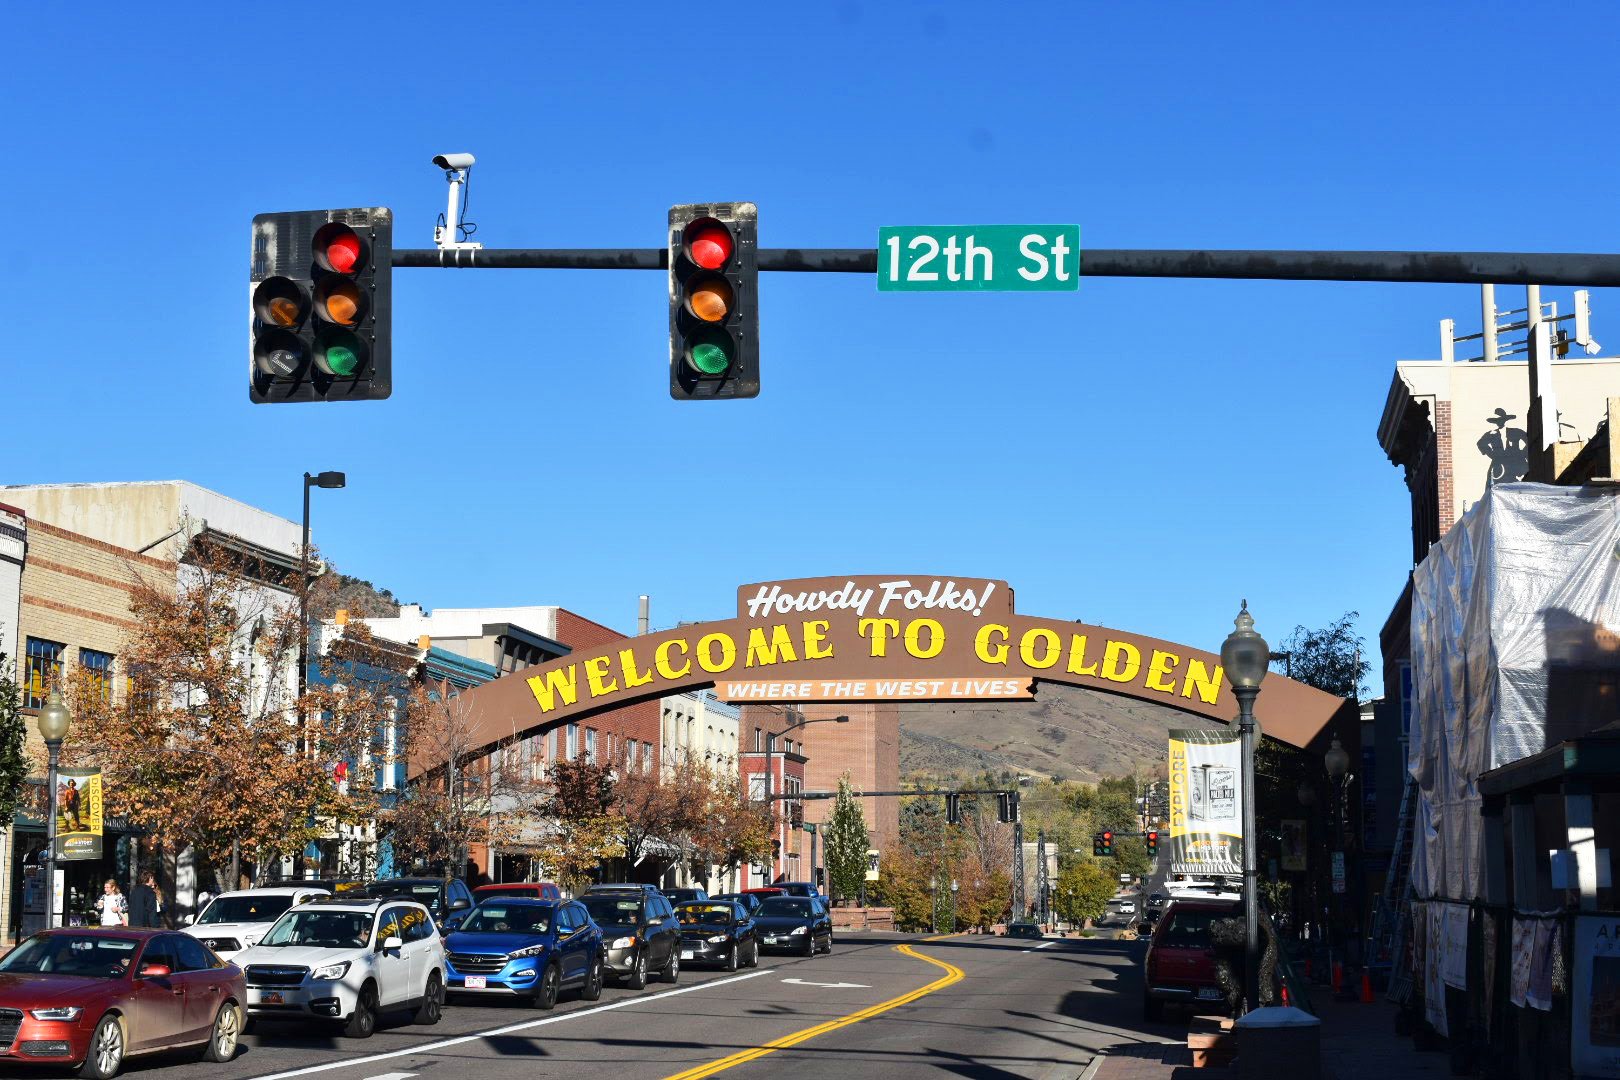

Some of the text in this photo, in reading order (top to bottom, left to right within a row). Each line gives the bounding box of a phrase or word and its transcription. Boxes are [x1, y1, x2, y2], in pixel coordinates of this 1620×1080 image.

[887, 233, 1070, 282] 12th St
[747, 580, 995, 617] Howdy Folks!
[525, 618, 1225, 713] WELCOME TO GOLDEN
[727, 680, 1018, 698] WHERE THE WEST LIVES
[91, 777, 100, 831] DISCOVER
[1172, 750, 1185, 827] EXPLORE
